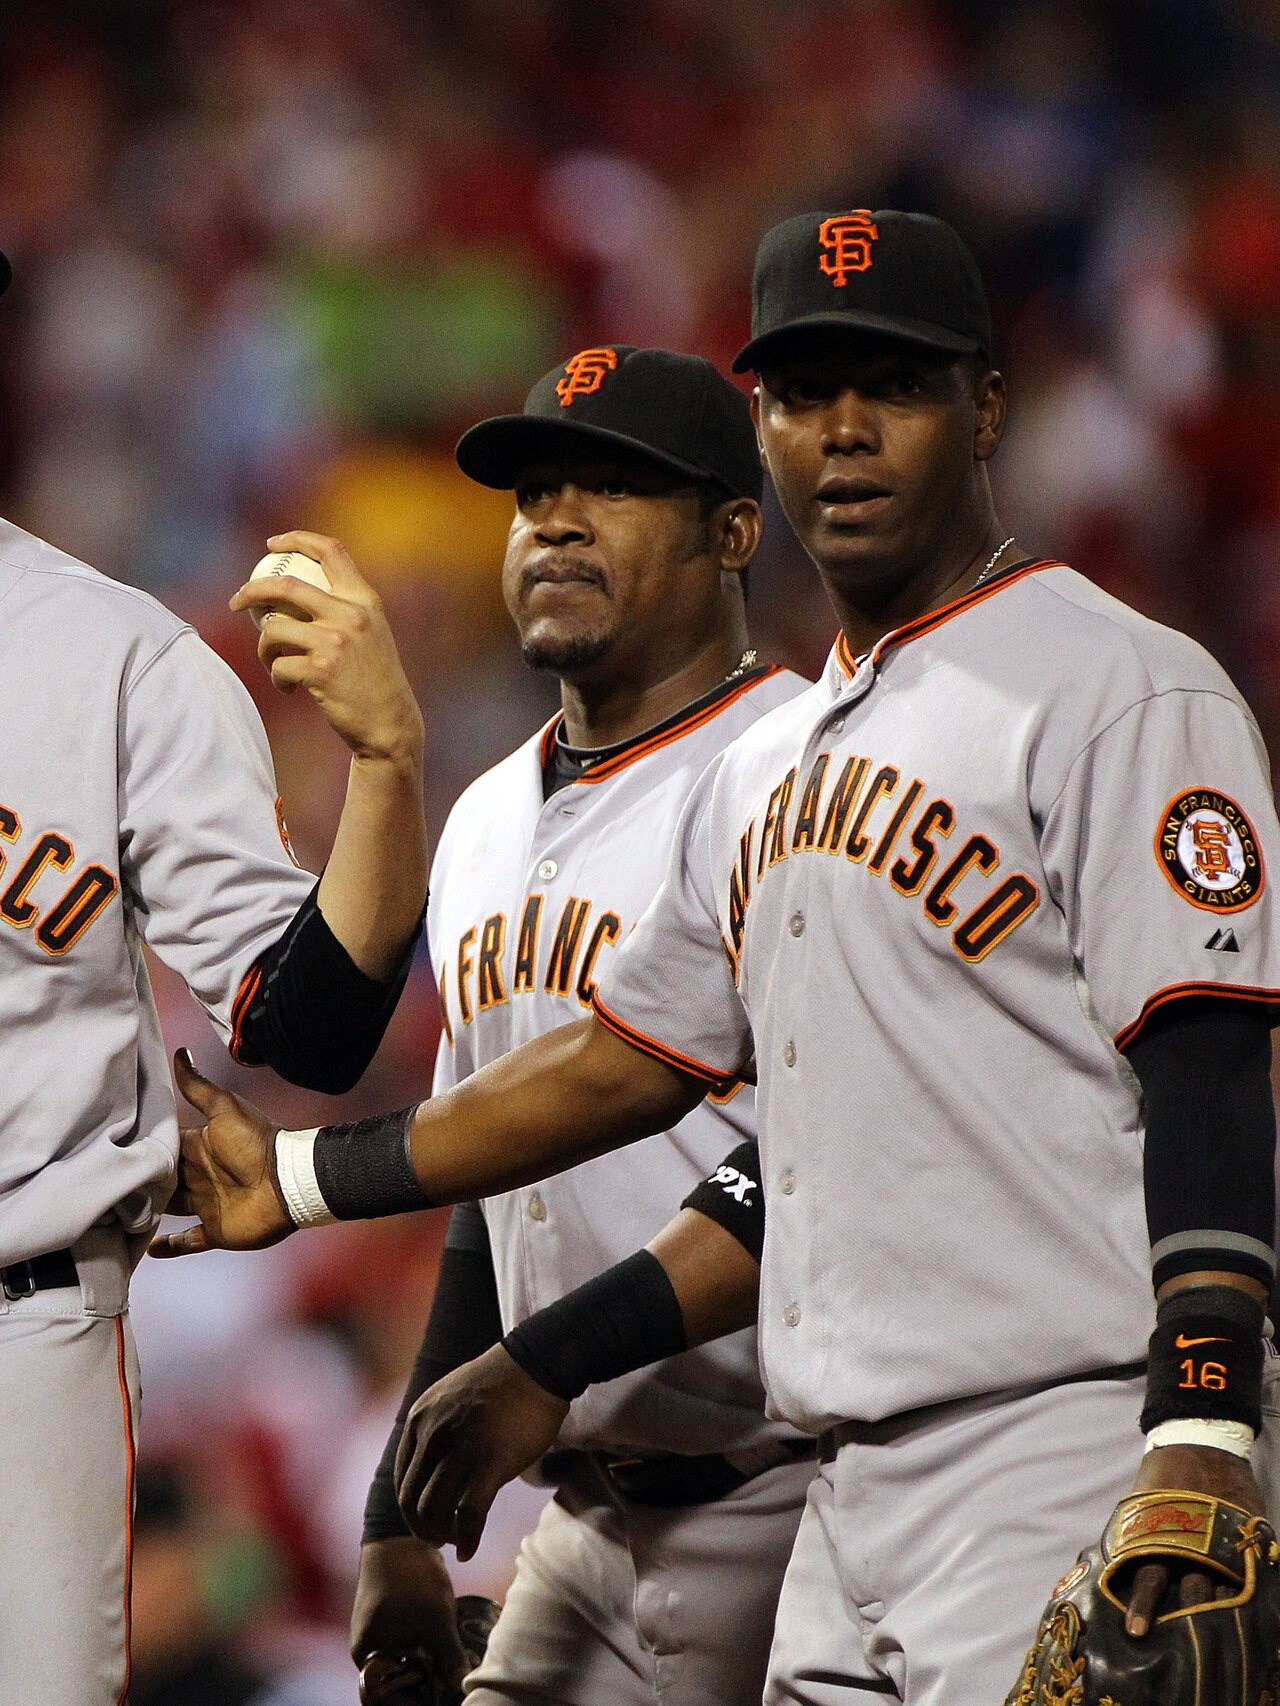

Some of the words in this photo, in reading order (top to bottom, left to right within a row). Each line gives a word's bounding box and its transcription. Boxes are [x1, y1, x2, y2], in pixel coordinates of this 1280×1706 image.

[819, 215, 879, 287] SF
[555, 348, 618, 408] SF
[718, 817, 756, 978] AN
[757, 752, 1040, 964] FRANCISCO
[1164, 816, 1182, 861] SAN
[1178, 795, 1257, 868] FRANCISCO
[1184, 880, 1252, 904] GIANTS
[458, 893, 637, 1026] FRANC
[1179, 1358, 1228, 1391] 16
